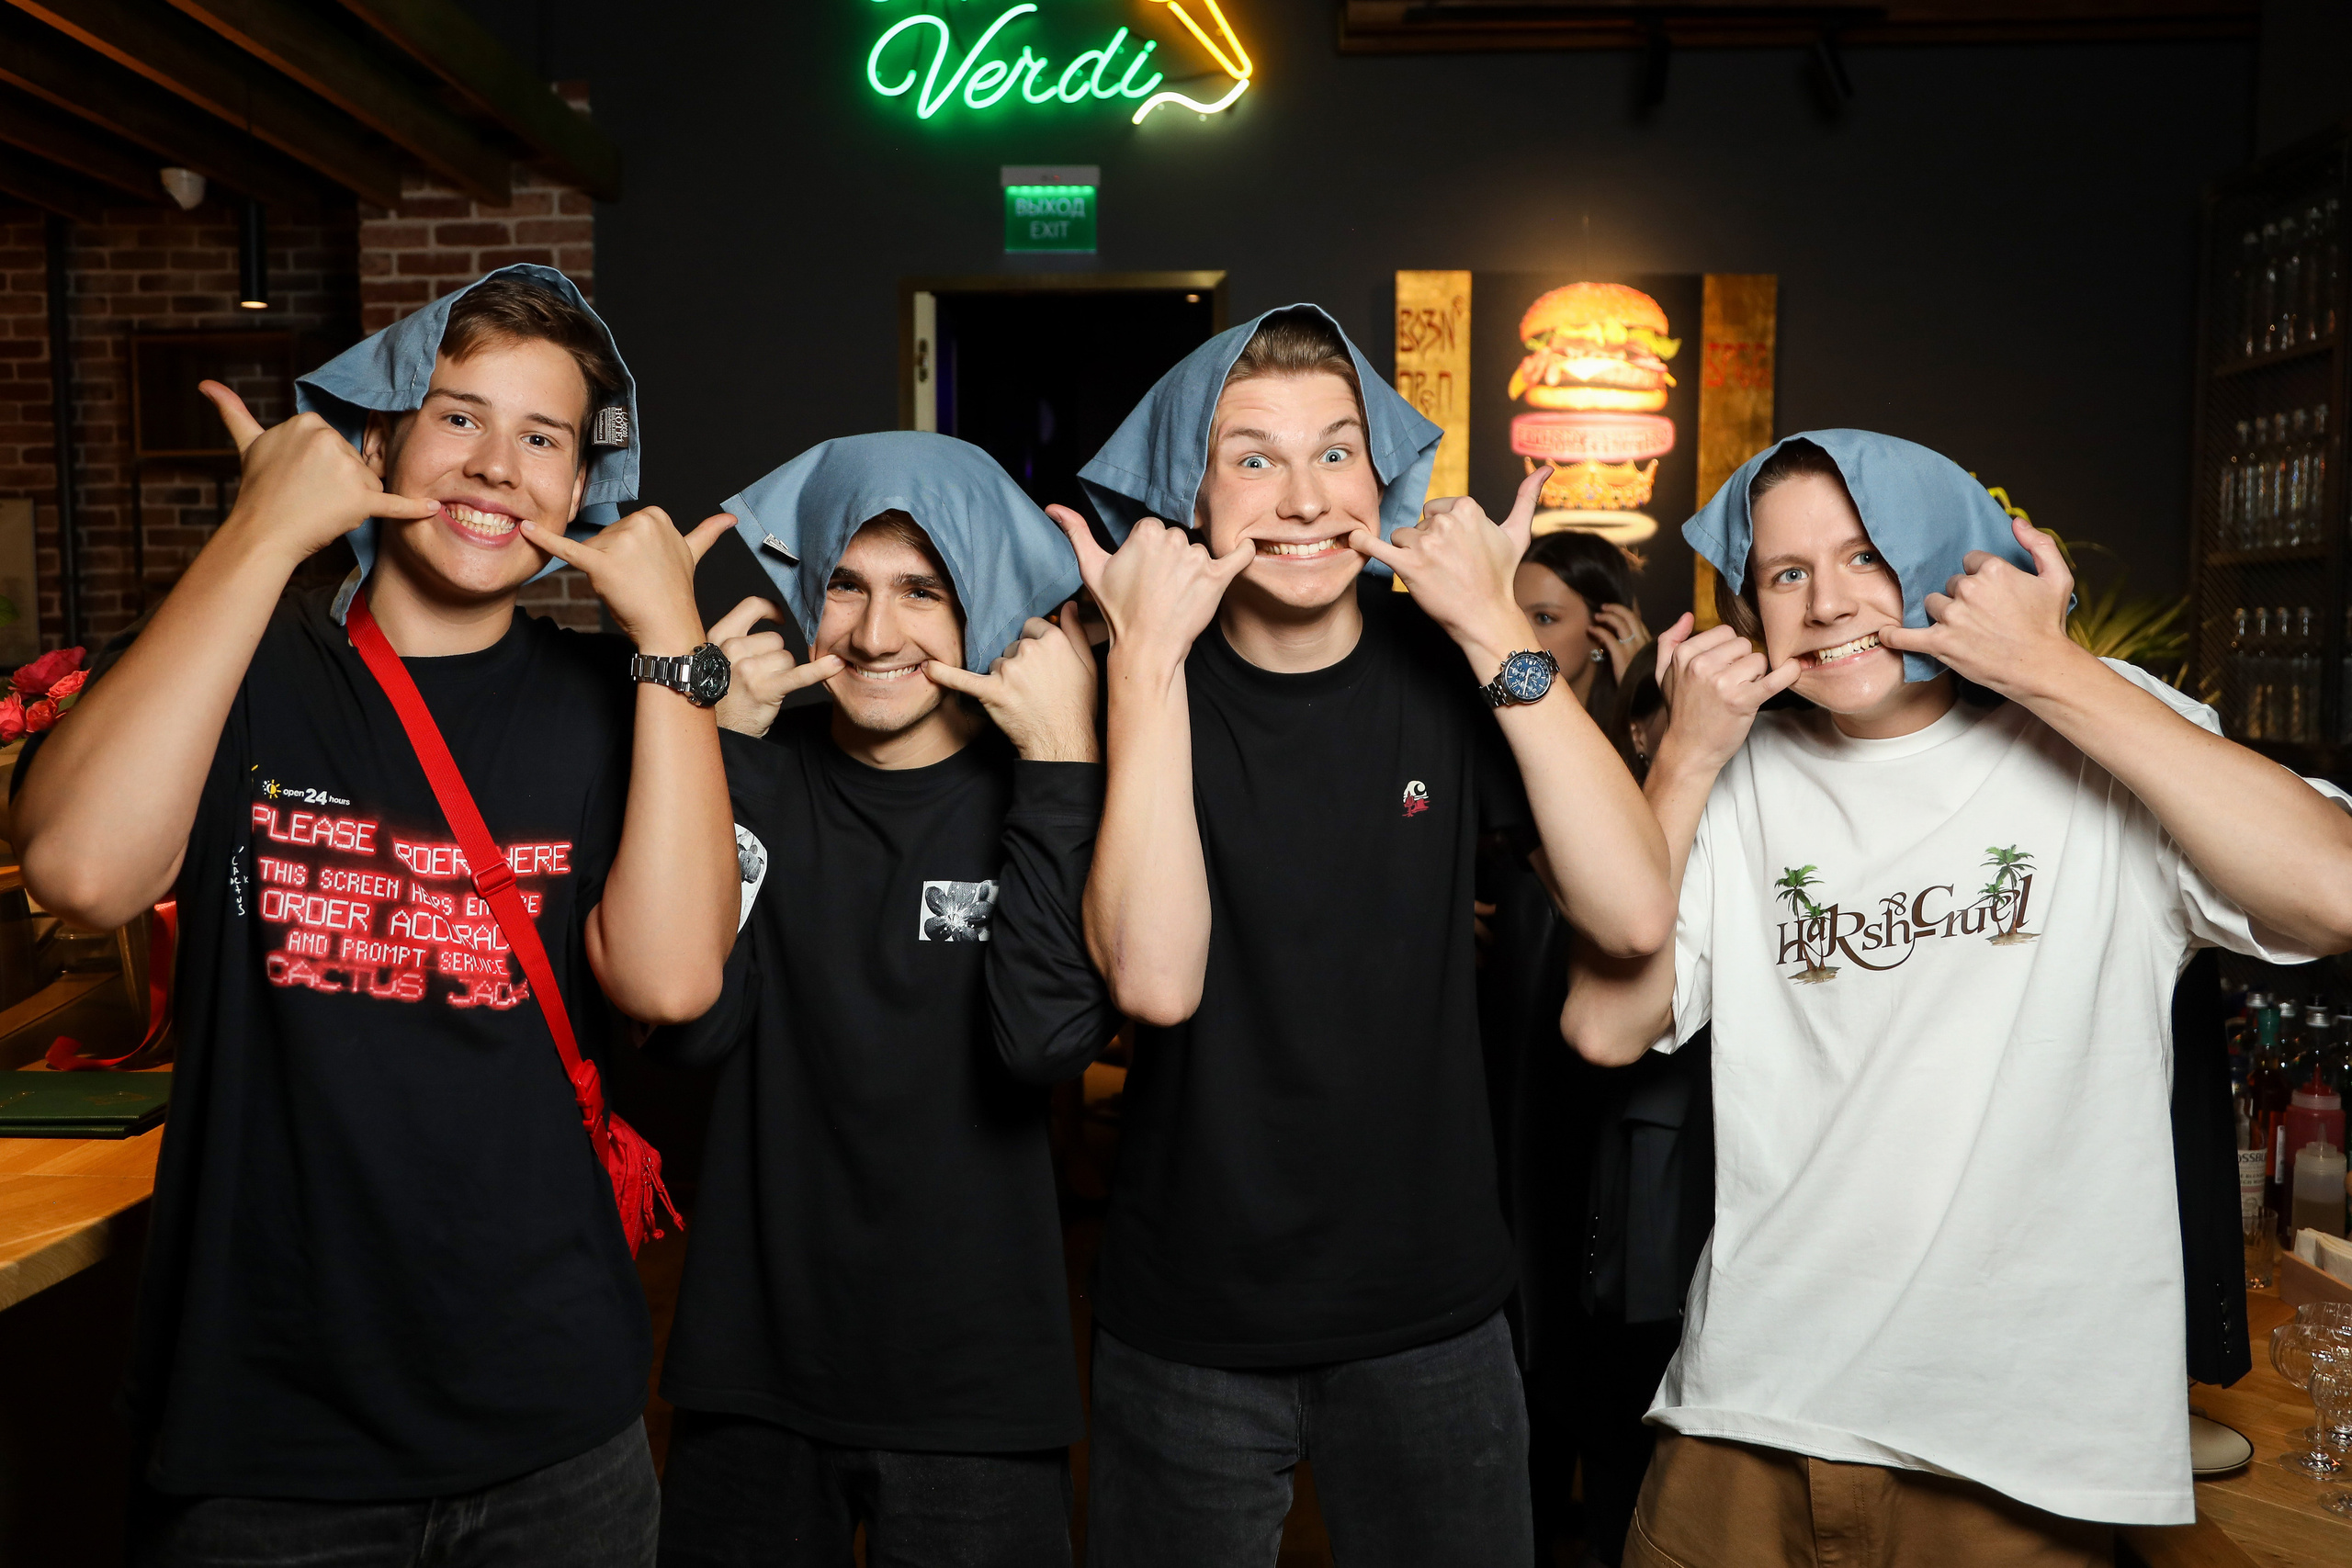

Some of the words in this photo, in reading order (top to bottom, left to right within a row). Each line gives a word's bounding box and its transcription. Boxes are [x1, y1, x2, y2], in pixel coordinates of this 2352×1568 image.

[867, 3, 1163, 119] Verdi
[1015, 197, 1085, 218] ВЫХОД
[1030, 220, 1069, 239] EXIT
[615, 407, 624, 445] HOTEL
[283, 788, 304, 797] open
[304, 788, 327, 805] 24
[329, 795, 350, 806] hours
[252, 807, 376, 852] PLEASE
[260, 859, 306, 885] THIS
[321, 869, 400, 898] SCREEN
[263, 890, 370, 931] ORDER
[288, 931, 328, 954] AND
[342, 938, 426, 967] PROMPT
[441, 952, 508, 975] SERVICE
[266, 954, 424, 998] CACTUS
